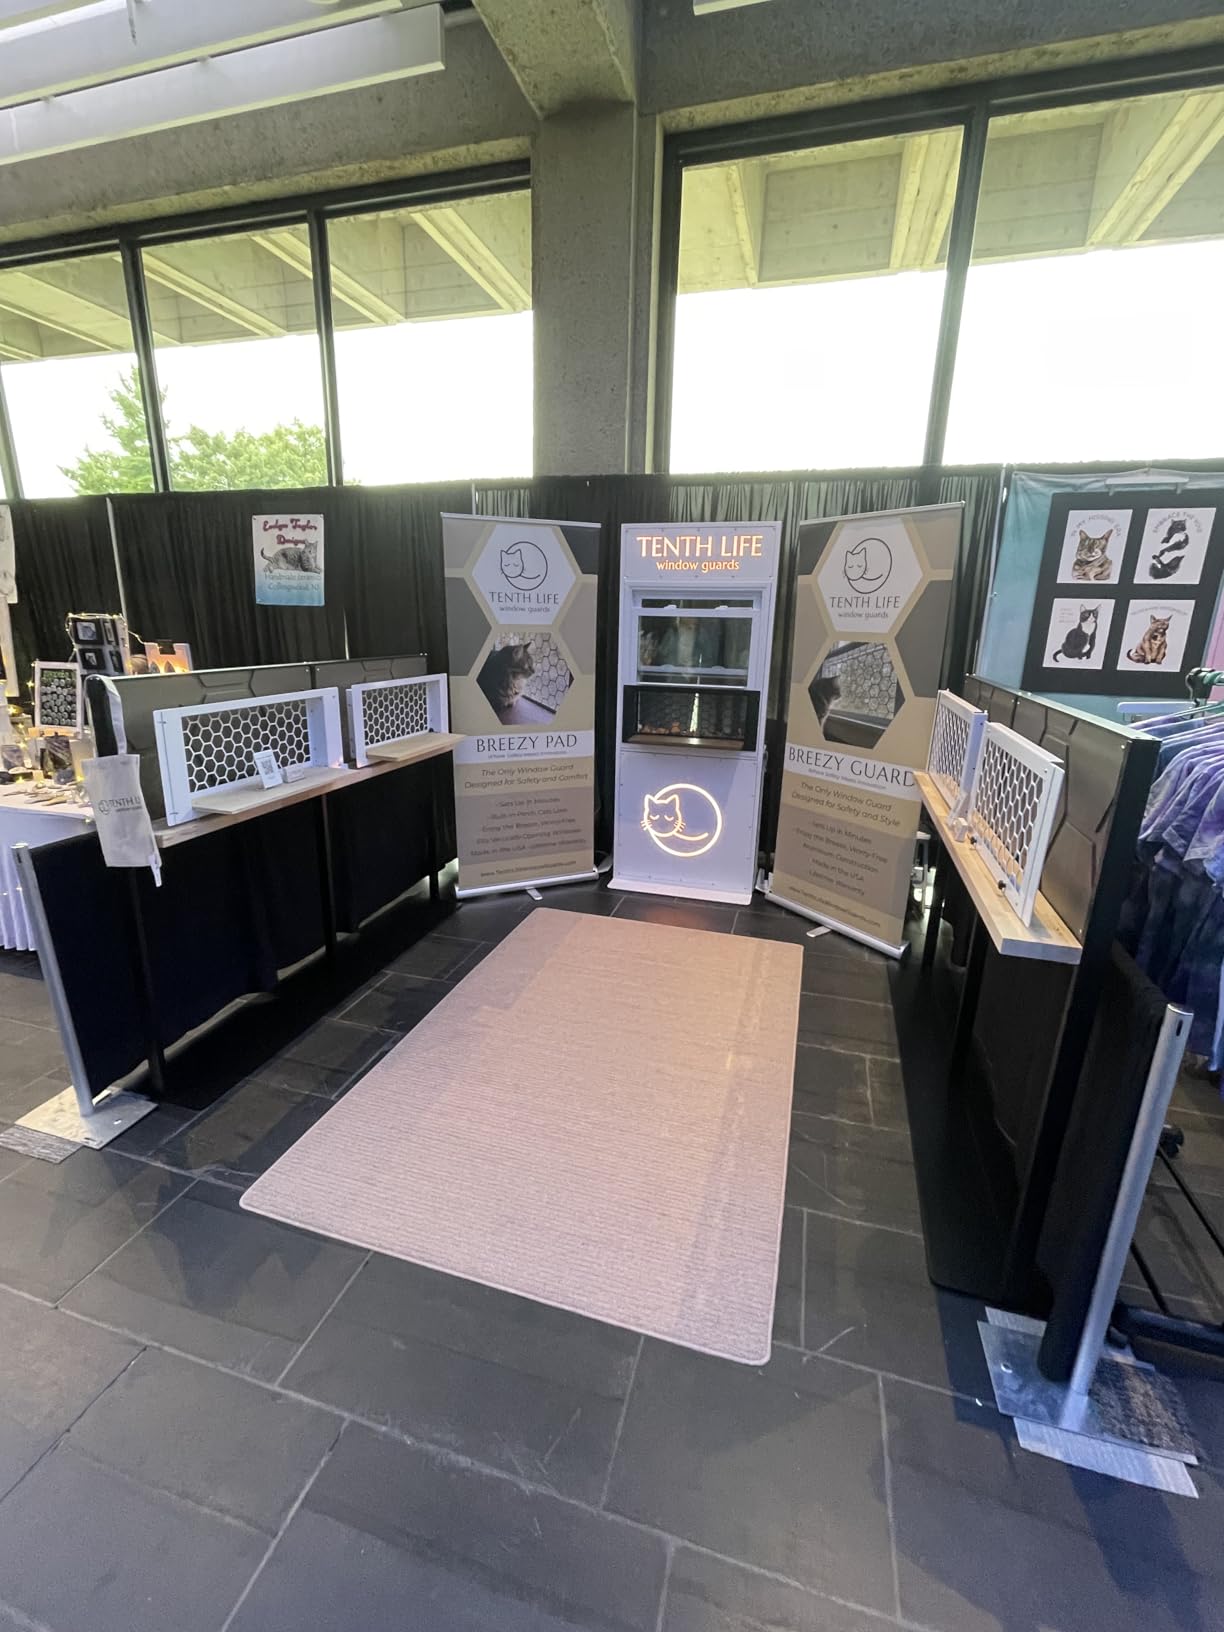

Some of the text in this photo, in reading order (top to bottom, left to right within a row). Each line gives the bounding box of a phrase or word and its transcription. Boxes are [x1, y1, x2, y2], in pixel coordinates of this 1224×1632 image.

[636, 535, 763, 557] TENTH LIFE
[656, 559, 739, 573] window guards
[489, 591, 559, 604] TENTH LIFE
[830, 596, 900, 609] TENTH LIFE
[476, 734, 577, 752] BREEZY PAD
[481, 764, 574, 777] The Only Window Guard
[789, 746, 845, 771] BREEZY
[850, 760, 916, 787] GUARD
[464, 779, 503, 789] Designed
[504, 778, 516, 786] for
[517, 776, 541, 785] Safety
[542, 775, 557, 783] and
[801, 782, 892, 812] The Only Window Guard
[792, 791, 901, 827] Designed for Safety and Style
